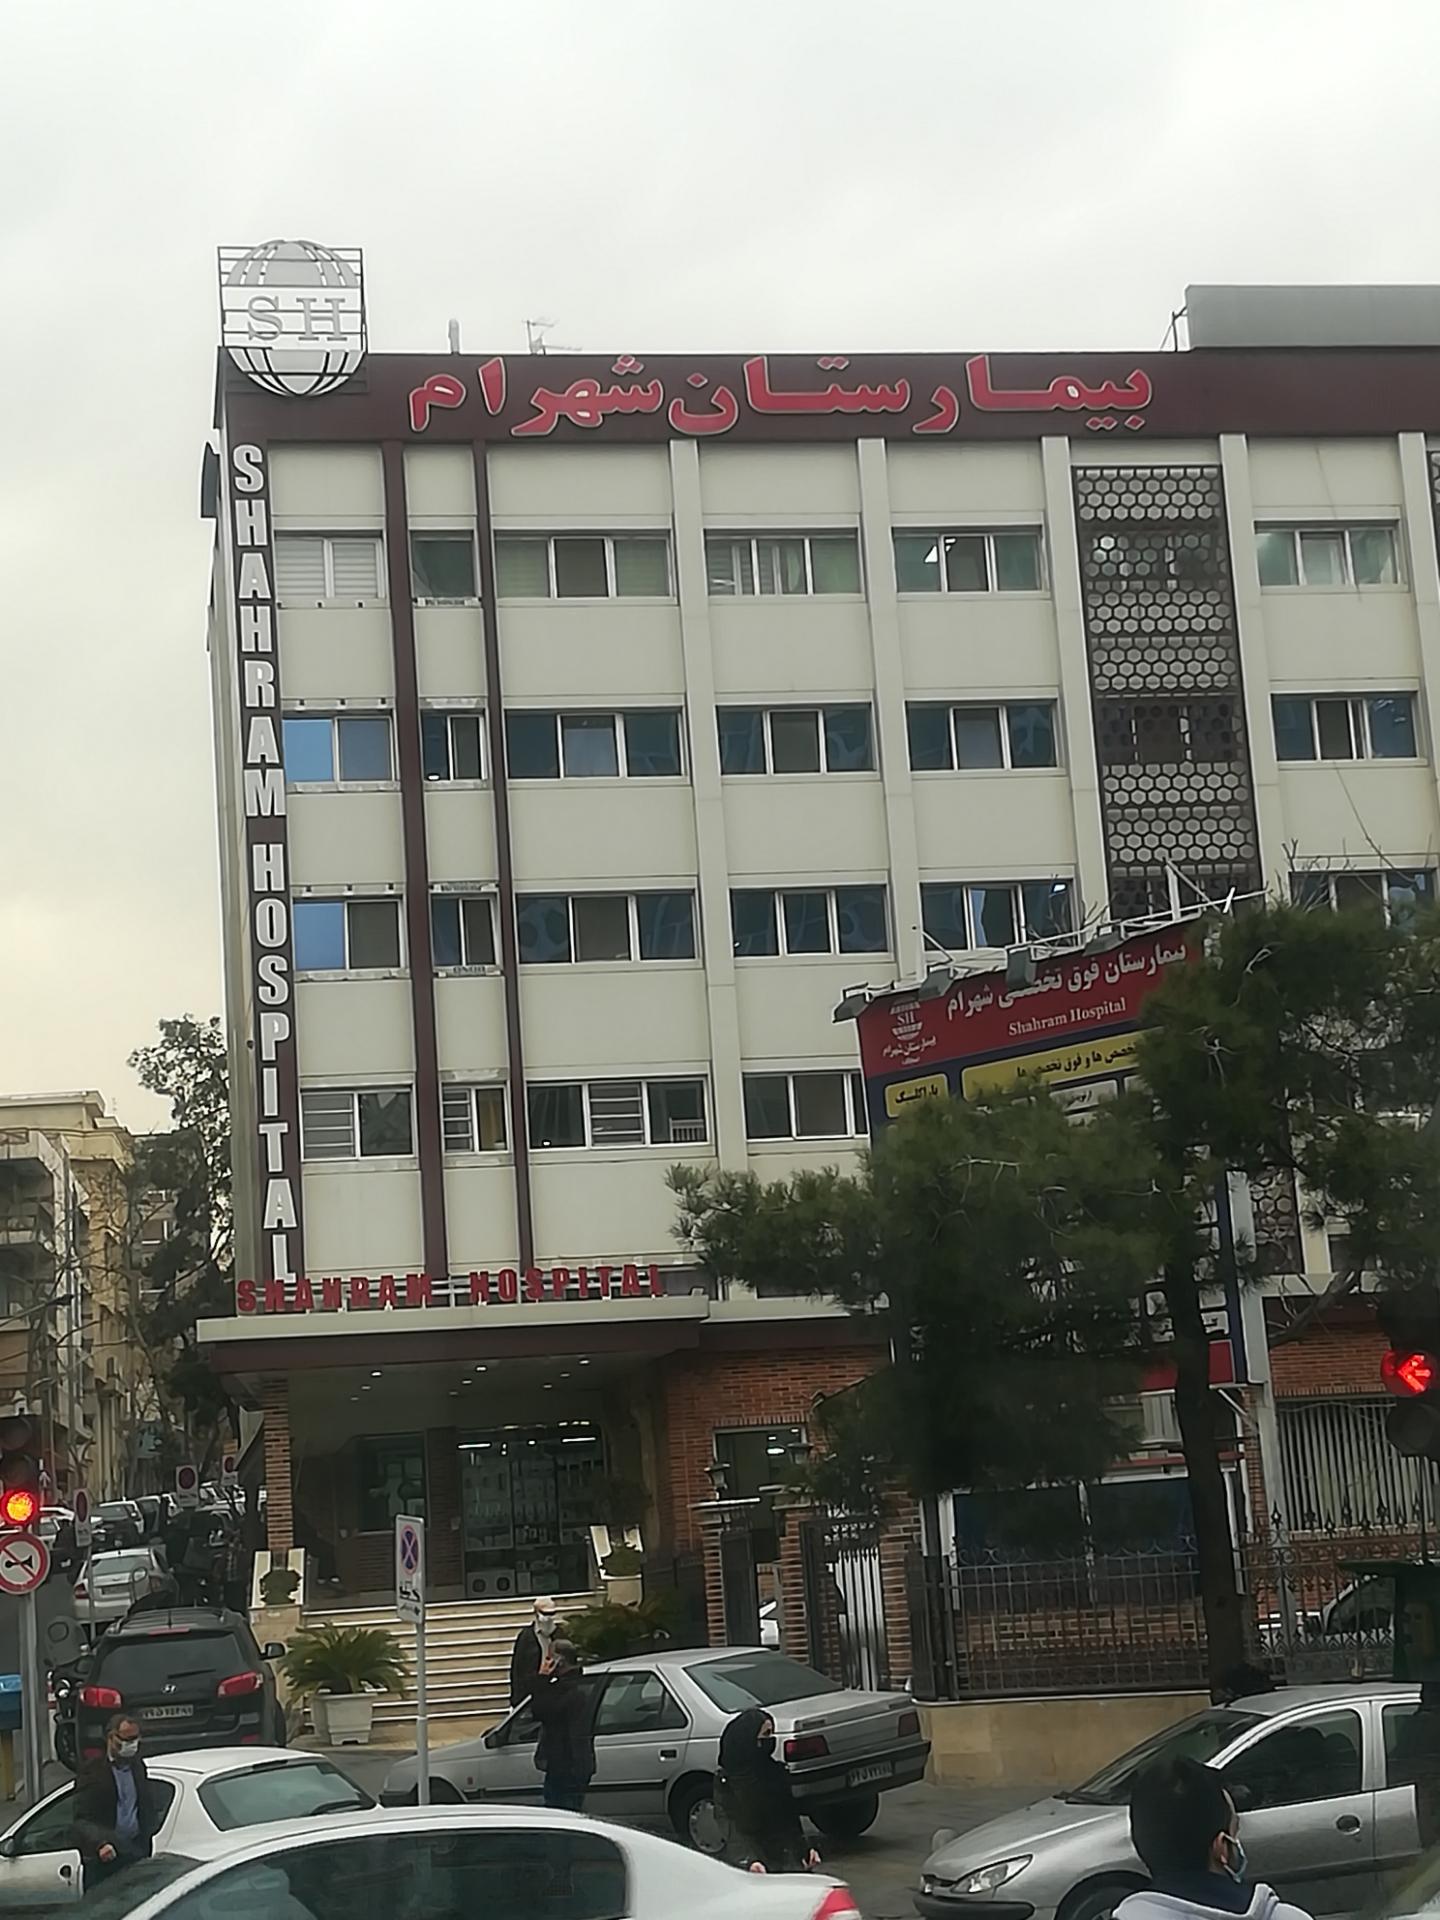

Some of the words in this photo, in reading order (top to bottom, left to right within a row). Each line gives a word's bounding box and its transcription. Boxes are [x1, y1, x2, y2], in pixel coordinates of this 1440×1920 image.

[247, 296, 348, 341] SH
[408, 354, 664, 437] شهرام
[668, 355, 1153, 436] بیمارستان
[232, 443, 288, 818] SHAHRAM
[1067, 957, 1100, 992] فوق
[946, 983, 994, 1020] شهرام
[1008, 1012, 1067, 1037] Shahram
[1070, 996, 1127, 1023] Hospital
[251, 842, 298, 1285] HOSPITAL
[237, 1273, 433, 1312] SHAHRAM
[469, 1264, 664, 1304] HOSPITAL
